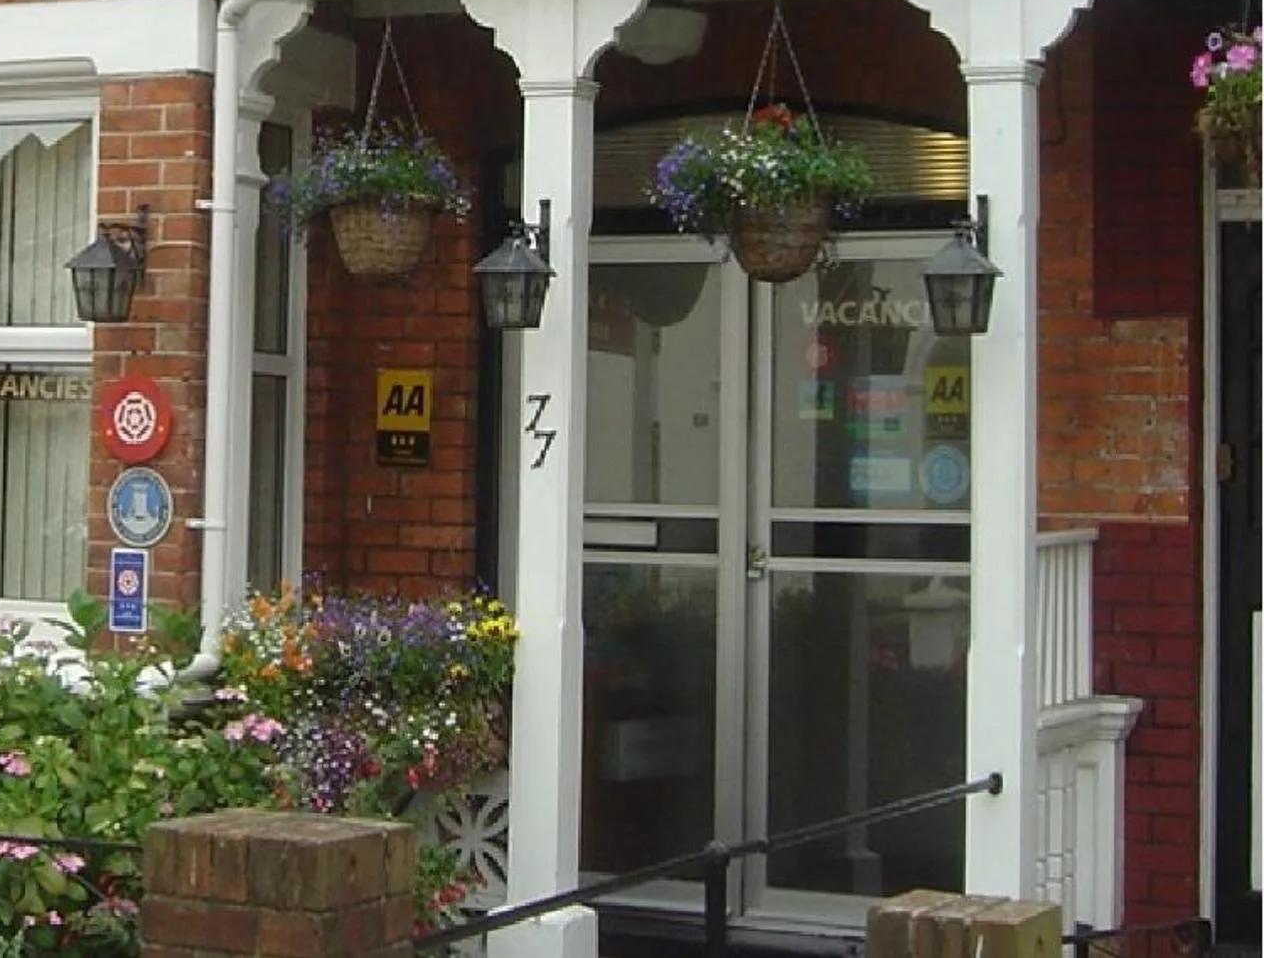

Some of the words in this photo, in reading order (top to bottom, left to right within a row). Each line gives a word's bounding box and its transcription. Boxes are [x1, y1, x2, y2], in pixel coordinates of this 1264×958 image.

[801, 300, 933, 324] VACANCI
[382, 384, 425, 417] AA
[931, 375, 965, 403] AA
[525, 394, 557, 470] 77
